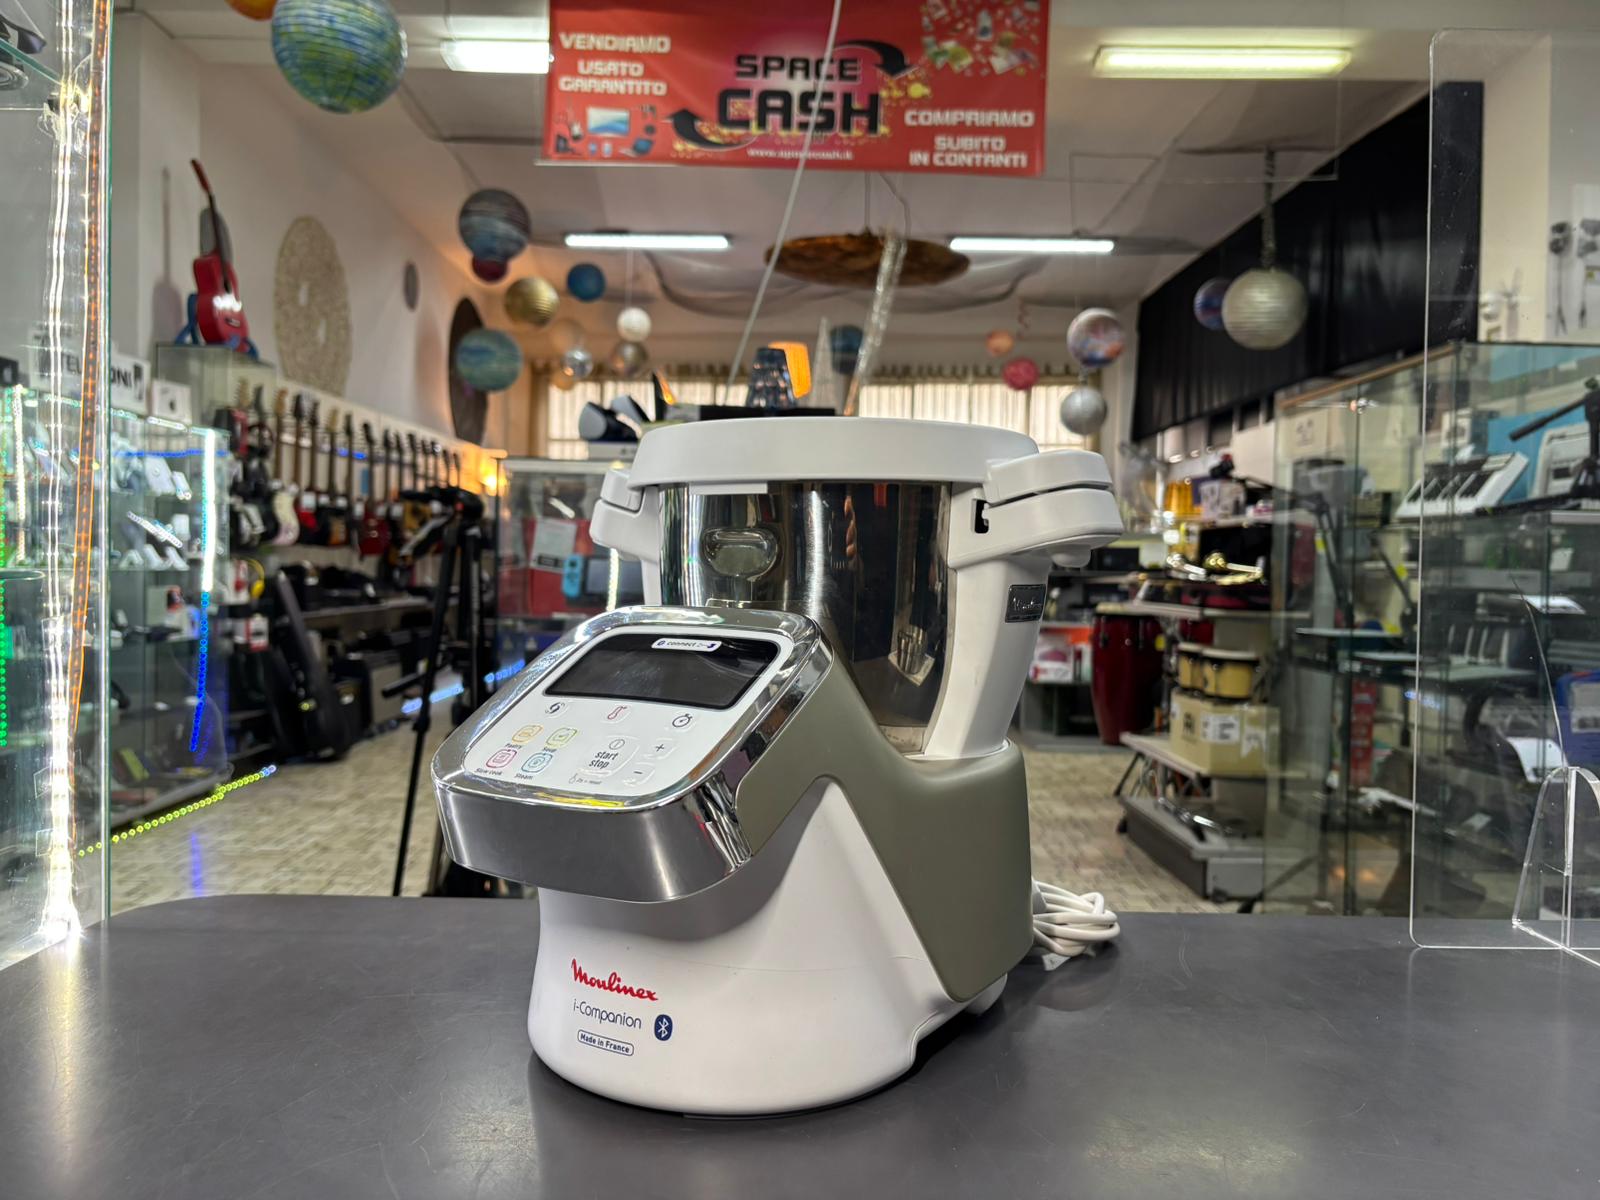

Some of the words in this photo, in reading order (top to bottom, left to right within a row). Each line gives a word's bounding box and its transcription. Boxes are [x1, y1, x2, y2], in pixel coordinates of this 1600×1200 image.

[559, 32, 671, 53] VENDIAMO
[577, 60, 644, 77] USATO
[736, 54, 859, 81] SPACE
[558, 76, 668, 96] GARANTITO
[718, 88, 880, 134] CASH
[904, 109, 1035, 127] COMPRIAMO
[934, 135, 1006, 152] SUBITO
[909, 151, 929, 167] IN
[932, 151, 1028, 169] CONTANTI
[588, 759, 610, 769] stop
[594, 751, 619, 761] start
[571, 958, 658, 1001] Moulinex
[573, 998, 641, 1030] i-Companion
[580, 1032, 597, 1045] Made
[597, 1037, 604, 1047] in
[605, 1040, 630, 1054] France
